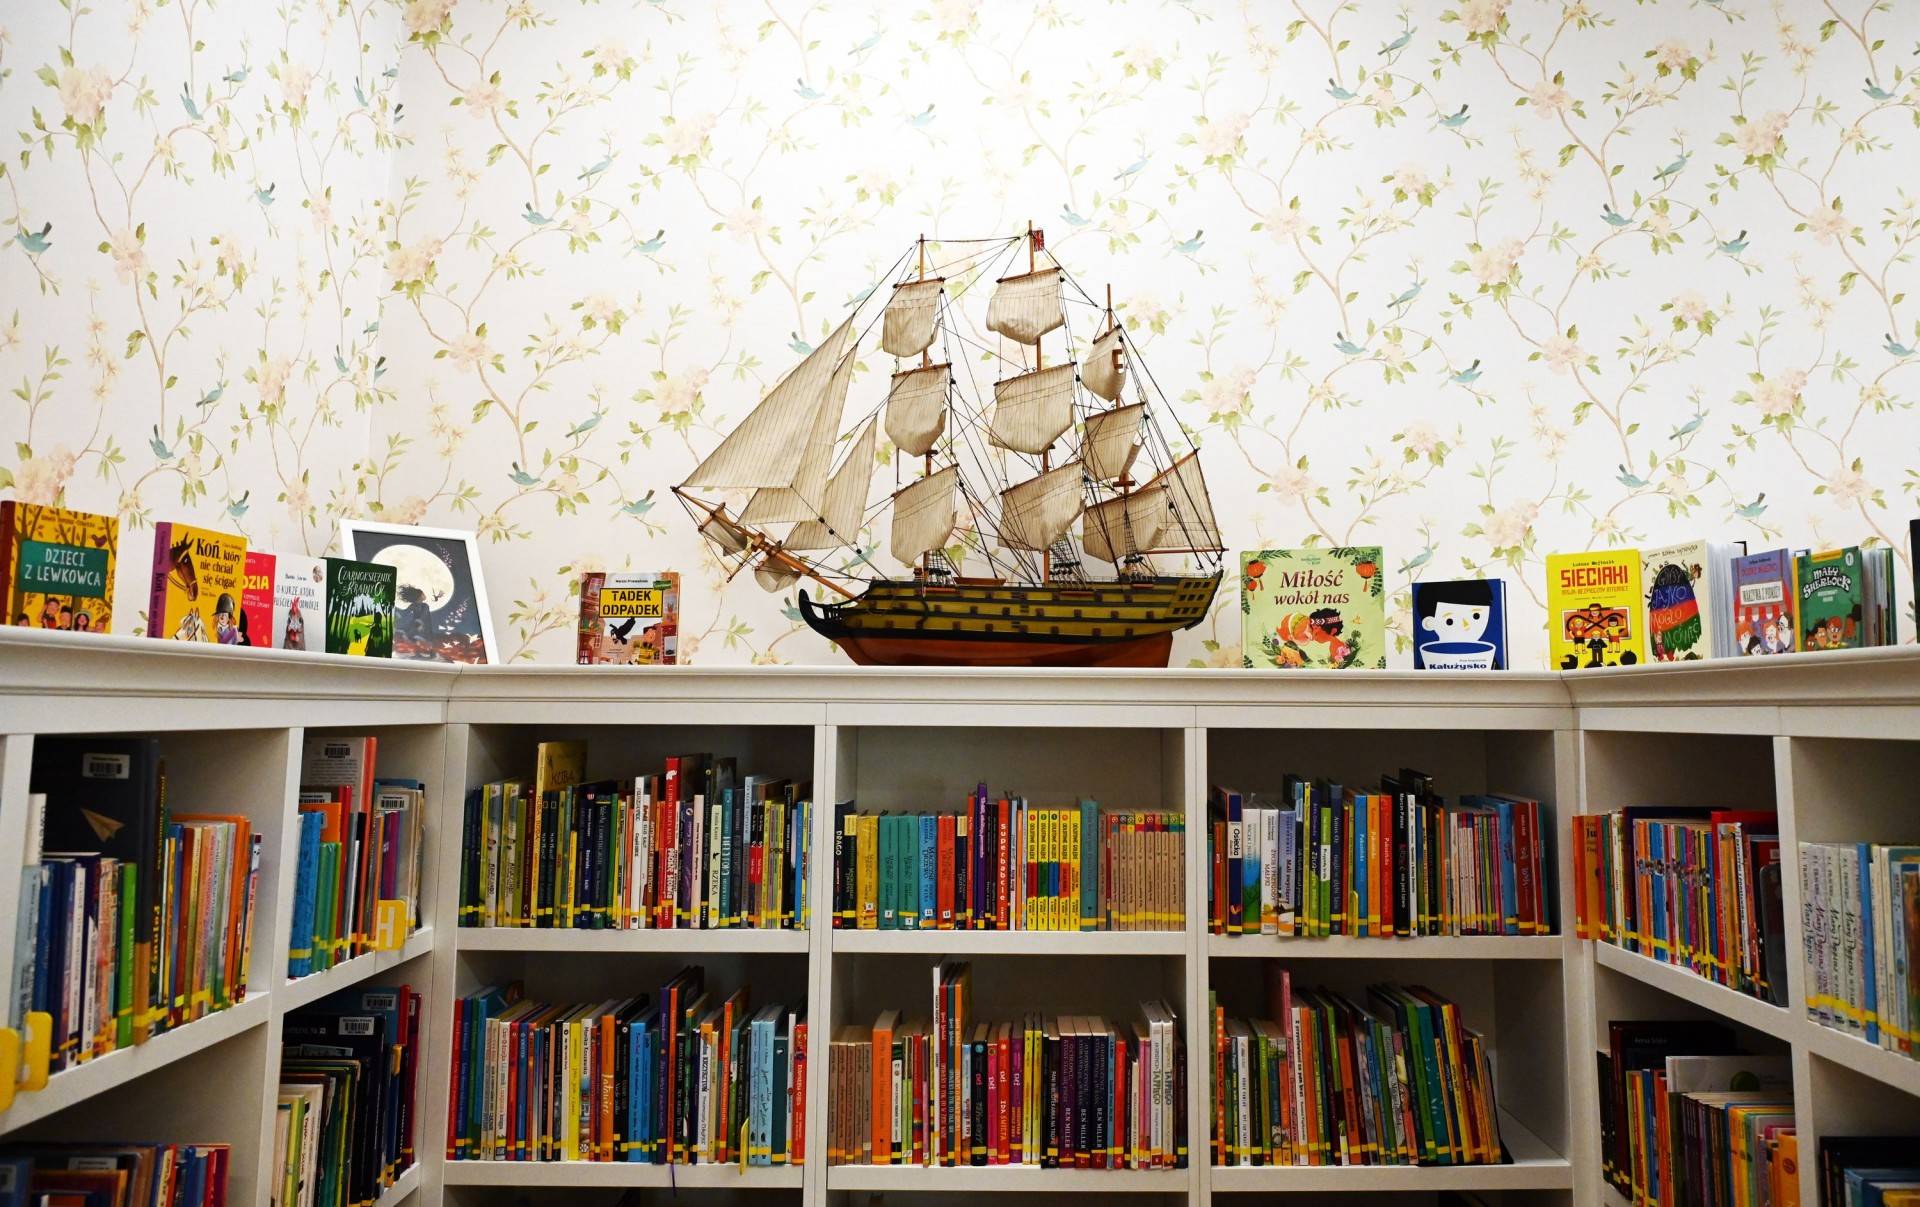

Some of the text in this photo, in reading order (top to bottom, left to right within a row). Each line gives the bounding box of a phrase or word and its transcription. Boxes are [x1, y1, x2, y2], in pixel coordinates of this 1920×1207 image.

[45, 548, 86, 567] DZIECI
[200, 560, 233, 575] nie chciał
[223, 549, 241, 562] który
[24, 564, 101, 587] Z LEWKOWCA
[203, 575, 237, 590] się ścigać
[1280, 569, 1343, 588] Miłość
[1561, 565, 1628, 588] SIECIAKI
[1803, 575, 1852, 599] SHERLOCK
[611, 590, 651, 602] TADEK
[1274, 591, 1350, 605] wokół nas
[602, 604, 659, 615] ODPADEK
[835, 830, 843, 856] DRAGO
[1804, 903, 1814, 928] Mary
[1813, 904, 1824, 932] Mary
[1828, 908, 1839, 935] Mary
[1845, 912, 1855, 938] Mary
[378, 906, 395, 950] H
[1804, 930, 1814, 965] Poppins
[1815, 934, 1826, 968] Poppins
[1831, 936, 1841, 972] Poppins
[1846, 940, 1856, 976] Poppins
[1153, 1070, 1161, 1105] TAPPIEGO
